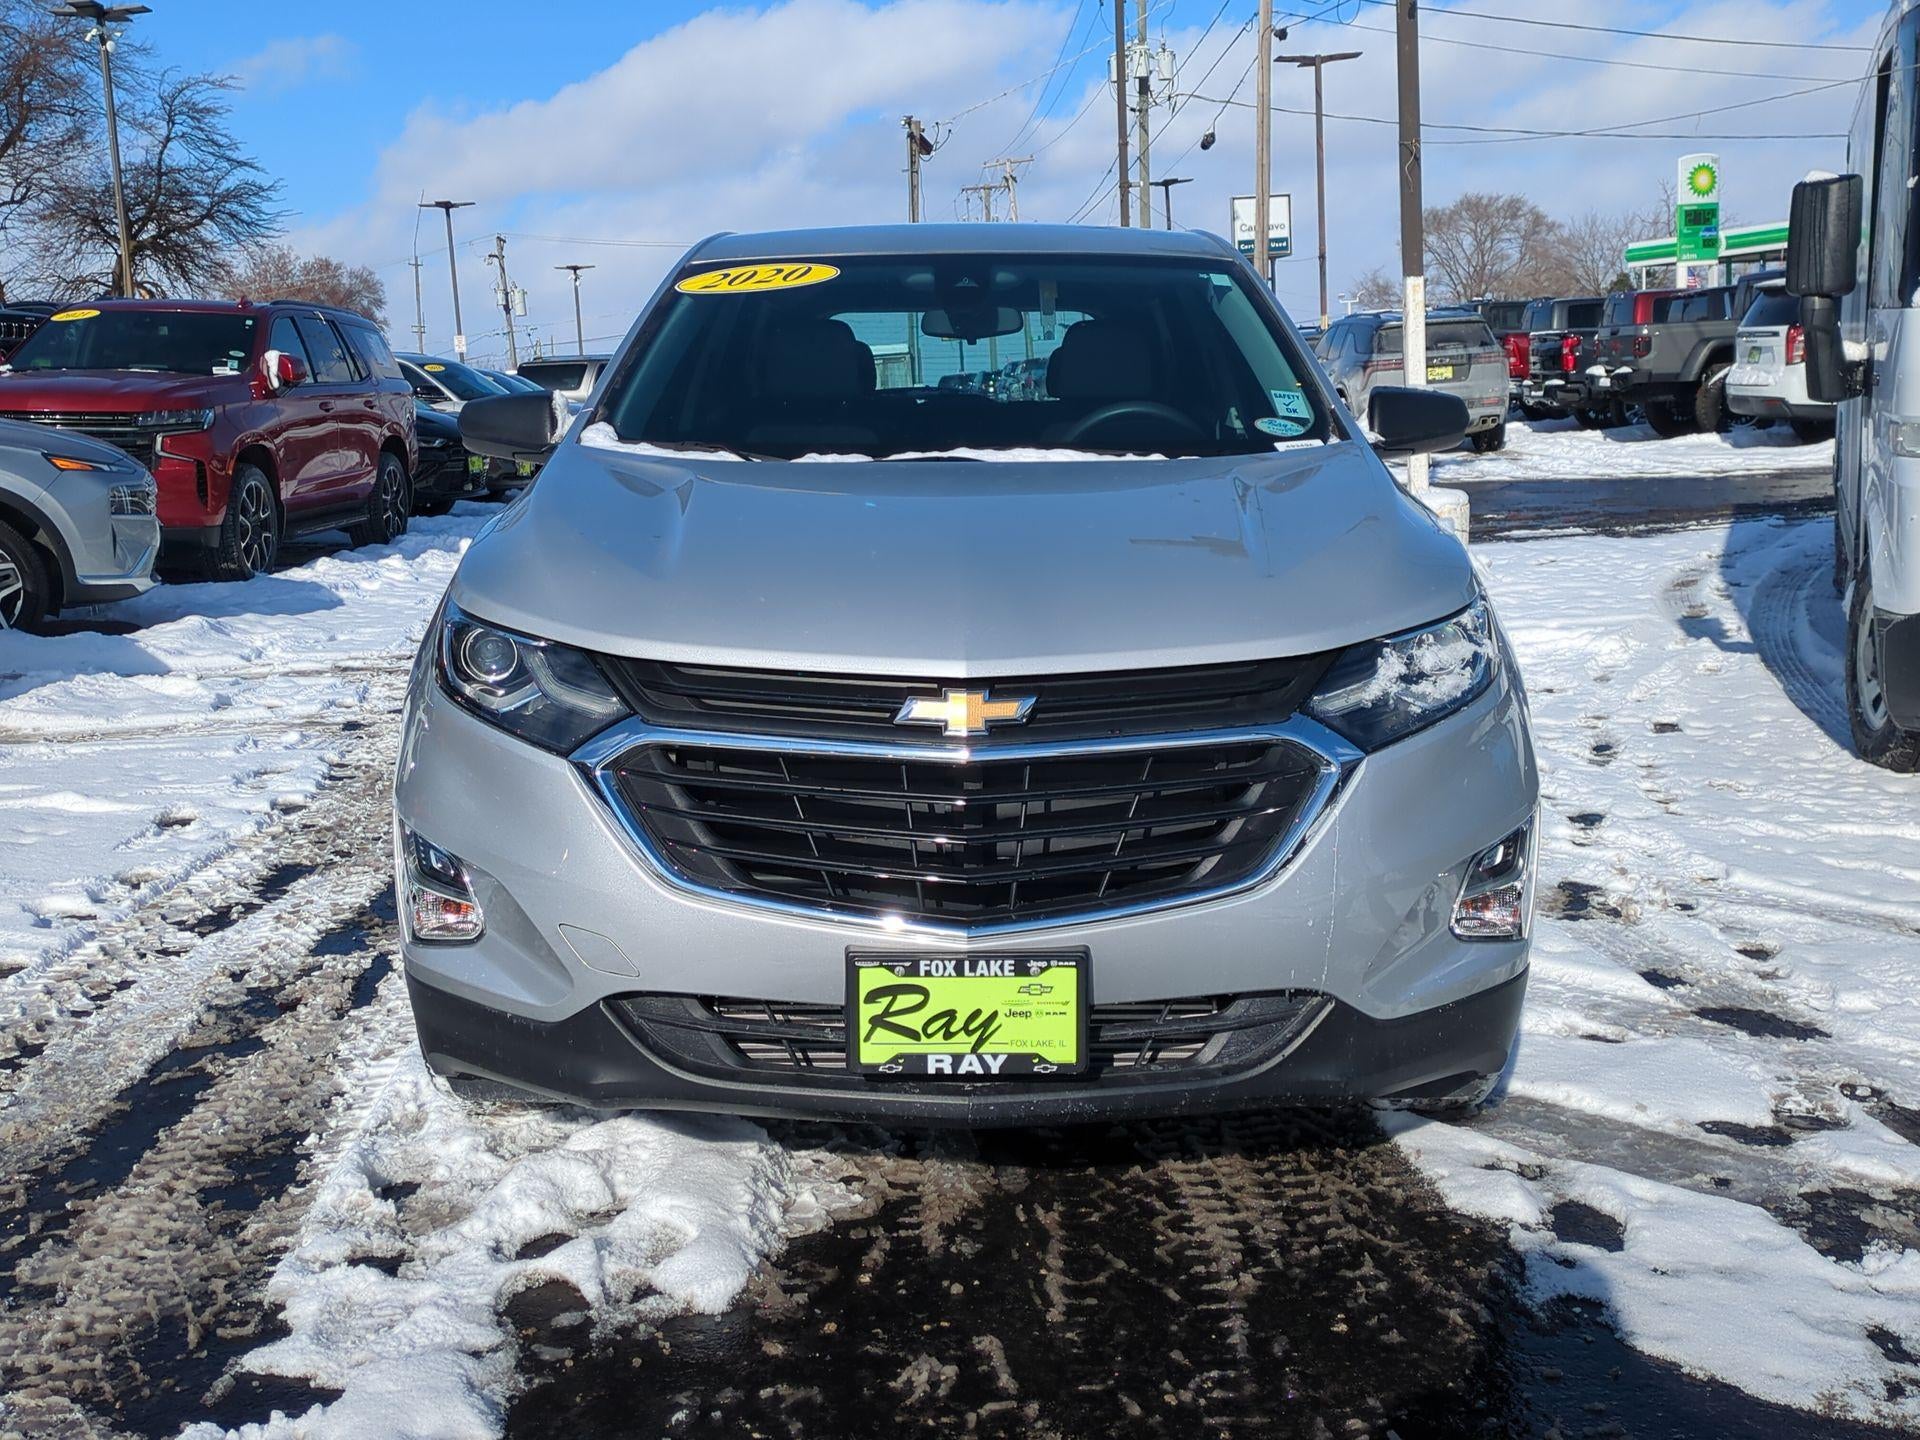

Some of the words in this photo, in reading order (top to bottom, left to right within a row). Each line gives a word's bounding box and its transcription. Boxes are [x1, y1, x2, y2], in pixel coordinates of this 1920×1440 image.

[697, 266, 813, 290] 2020
[919, 960, 958, 977] FOX
[963, 960, 1015, 977] LAKE
[1026, 959, 1048, 968] Jeep
[863, 983, 1002, 1054] Ray
[1004, 1008, 1033, 1019] Jeep
[1010, 1039, 1028, 1048] FOX
[1030, 1039, 1057, 1048] LAKE,
[1059, 1039, 1067, 1047] IL
[927, 1054, 1008, 1074] RAY
